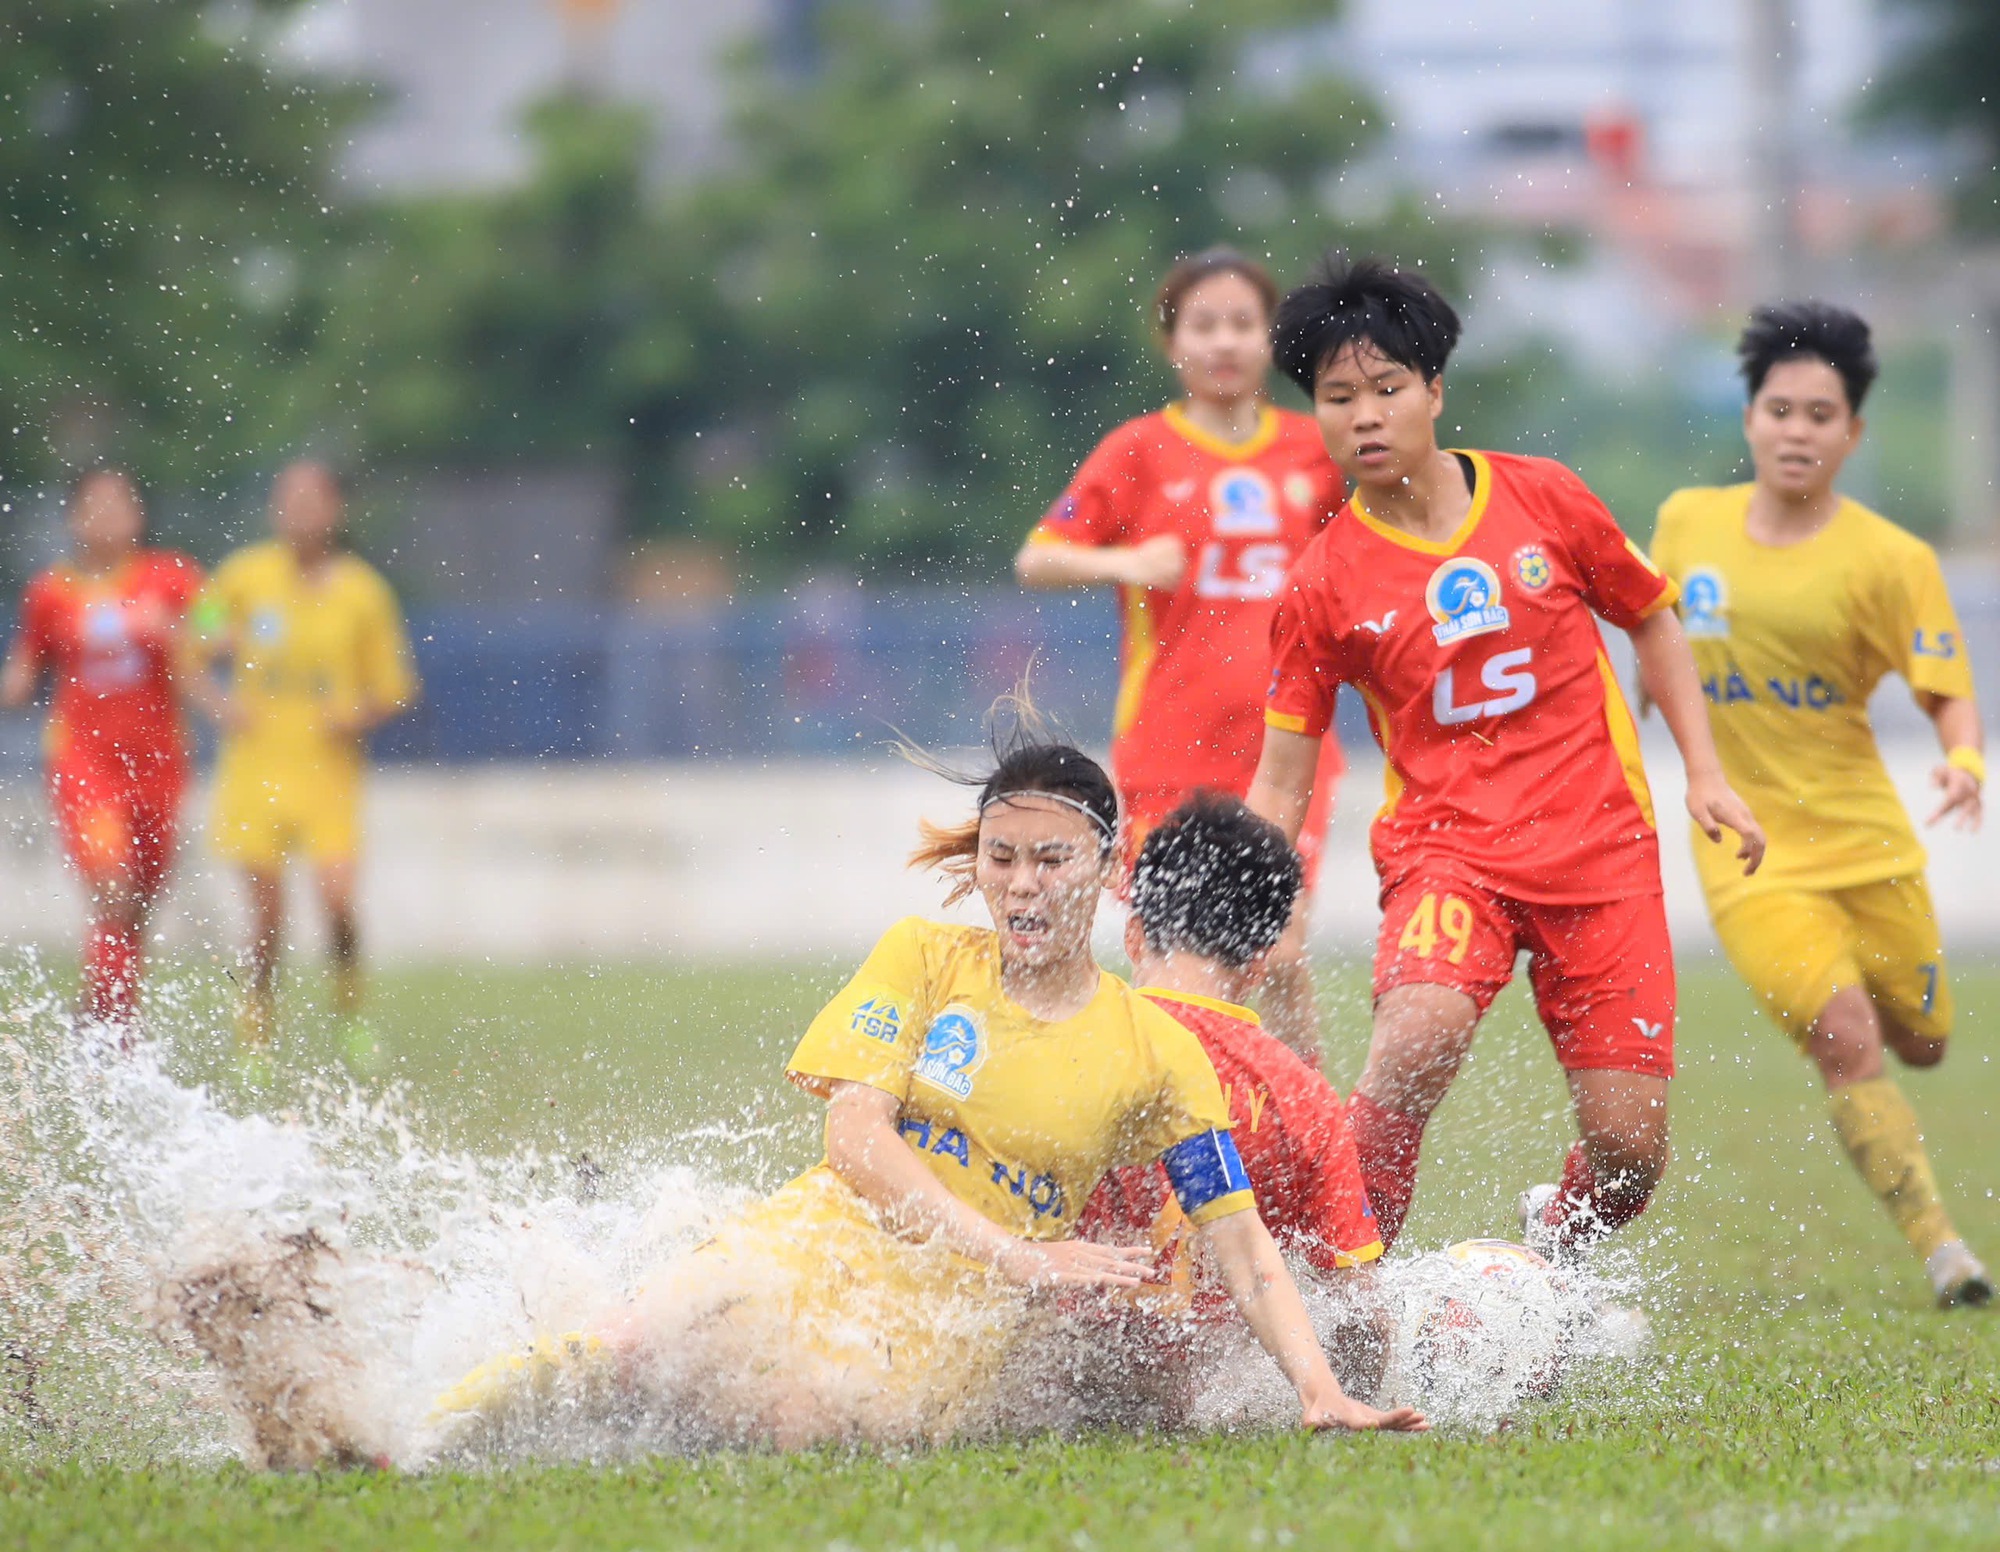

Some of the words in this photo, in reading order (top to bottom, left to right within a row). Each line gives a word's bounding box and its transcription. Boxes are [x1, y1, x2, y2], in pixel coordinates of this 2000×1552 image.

[1199, 543, 1288, 598] LS
[1914, 628, 1955, 659] LS
[1433, 647, 1537, 726] LS
[1398, 891, 1474, 965] 49
[1916, 963, 1938, 1015] 7
